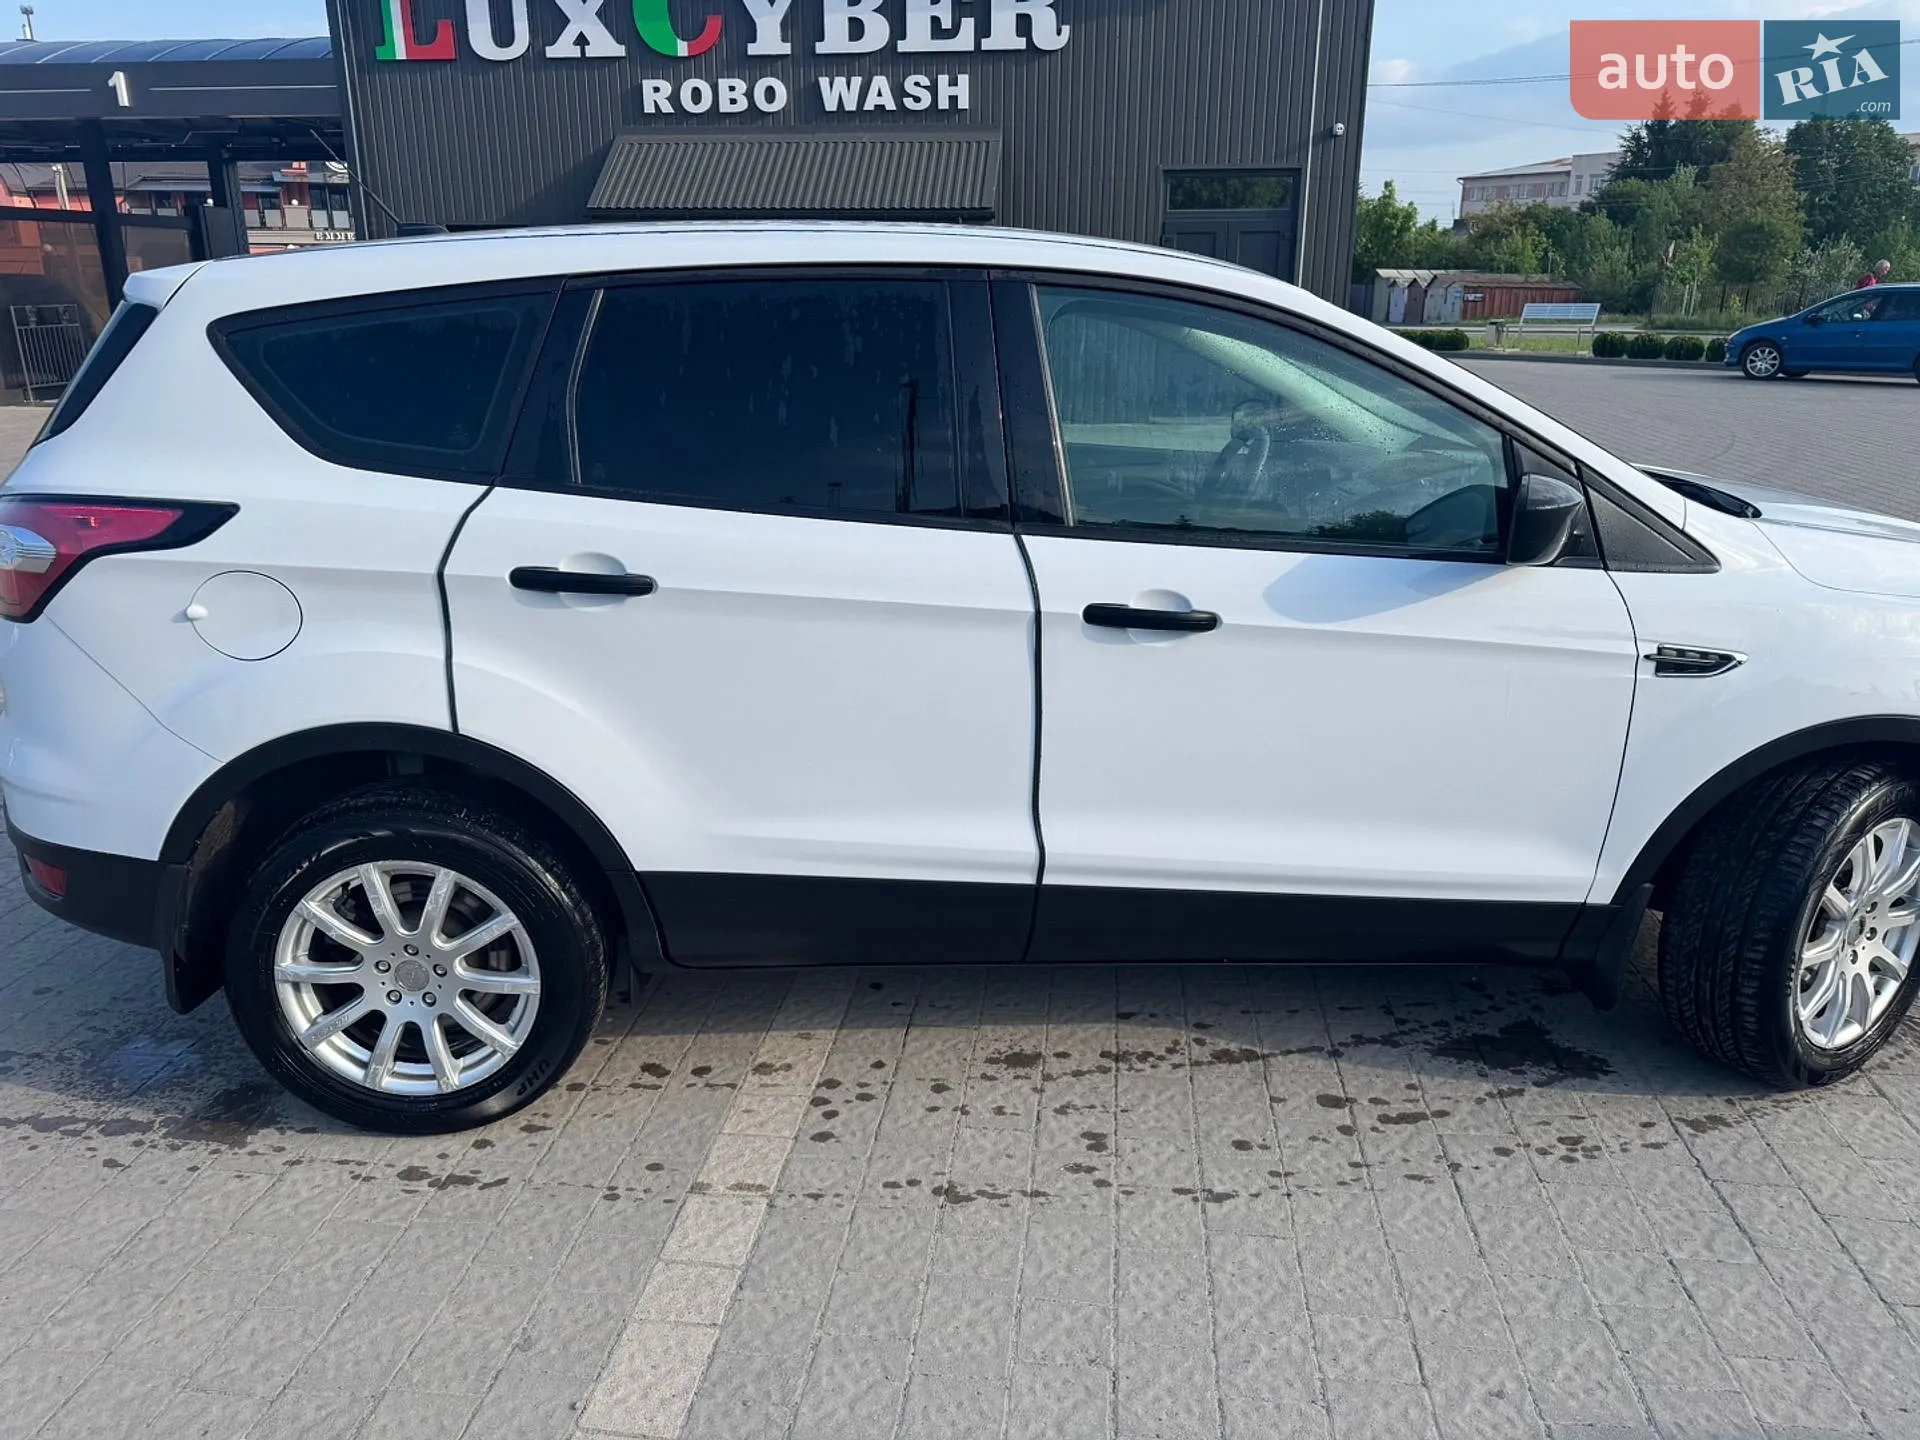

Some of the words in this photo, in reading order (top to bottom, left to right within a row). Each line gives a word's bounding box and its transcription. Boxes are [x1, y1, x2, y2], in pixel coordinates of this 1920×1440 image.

[107, 71, 129, 107] 1
[641, 77, 788, 114] ROBO
[818, 74, 970, 112] WASH
